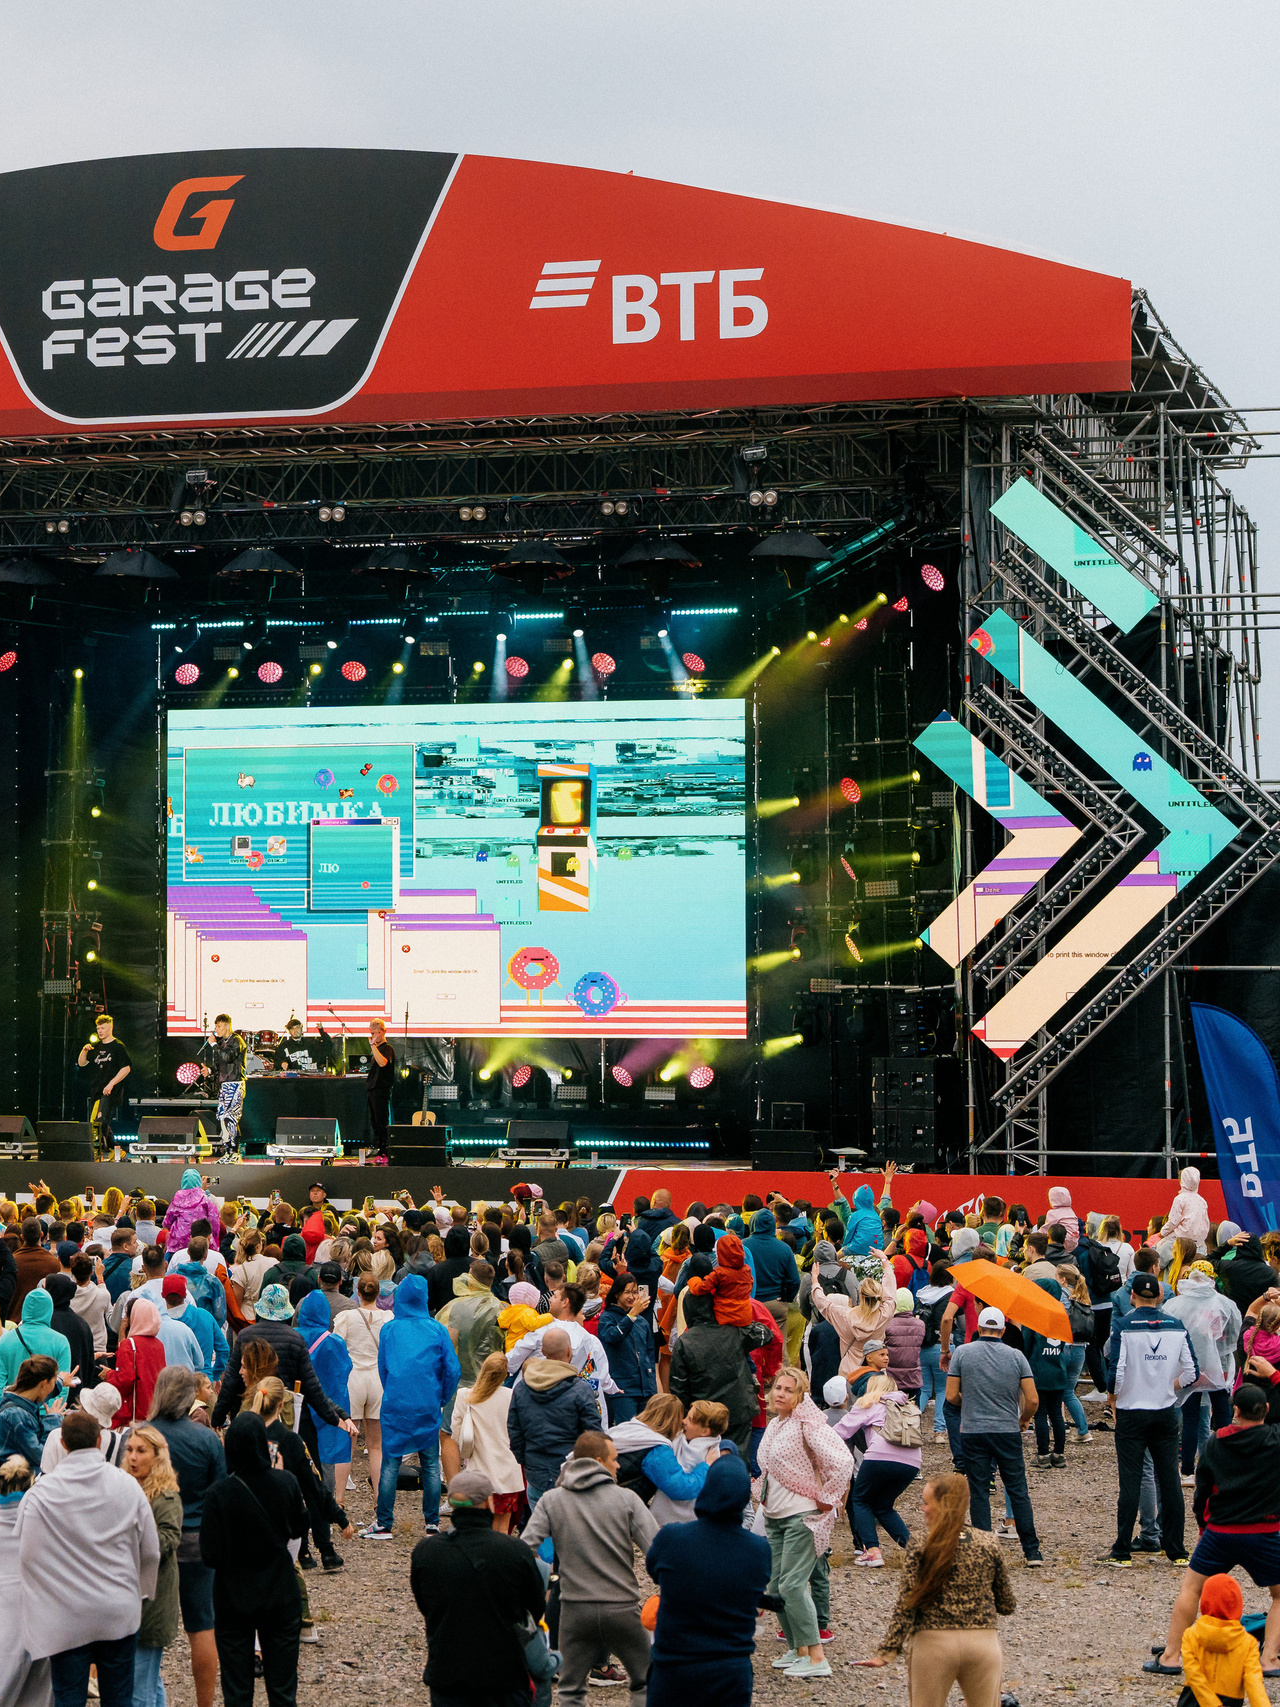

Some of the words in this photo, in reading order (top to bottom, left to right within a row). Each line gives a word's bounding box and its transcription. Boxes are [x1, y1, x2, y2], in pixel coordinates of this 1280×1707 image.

[609, 267, 769, 345] ВТБ
[318, 862, 340, 874] ЛЮ
[1055, 951, 1070, 959] print
[1144, 1353, 1168, 1361] Rexona
